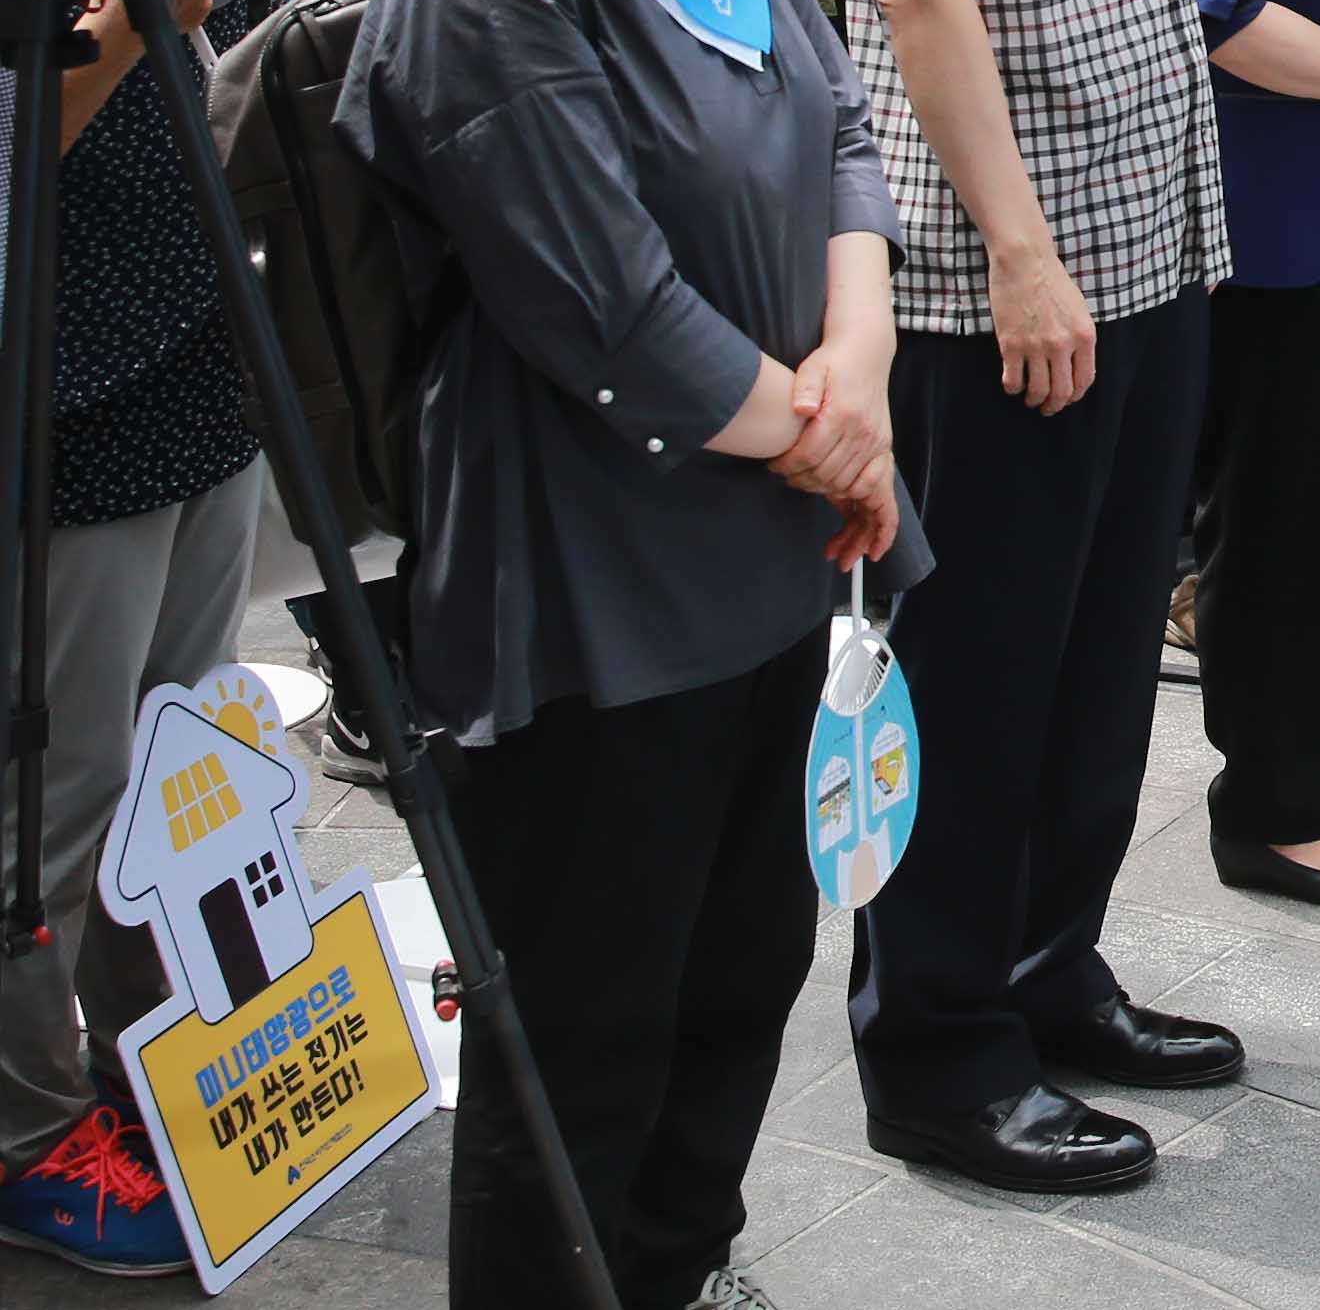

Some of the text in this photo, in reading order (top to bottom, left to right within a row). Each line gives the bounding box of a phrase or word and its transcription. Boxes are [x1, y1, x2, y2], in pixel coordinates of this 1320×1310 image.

[195, 964, 357, 1109] 미니태양광으로
[209, 1091, 257, 1151] 내가
[260, 1061, 305, 1113] 쓰는
[303, 1012, 369, 1075] 전기는
[242, 1117, 289, 1177] 내가
[289, 1058, 366, 1139] 만든다!
